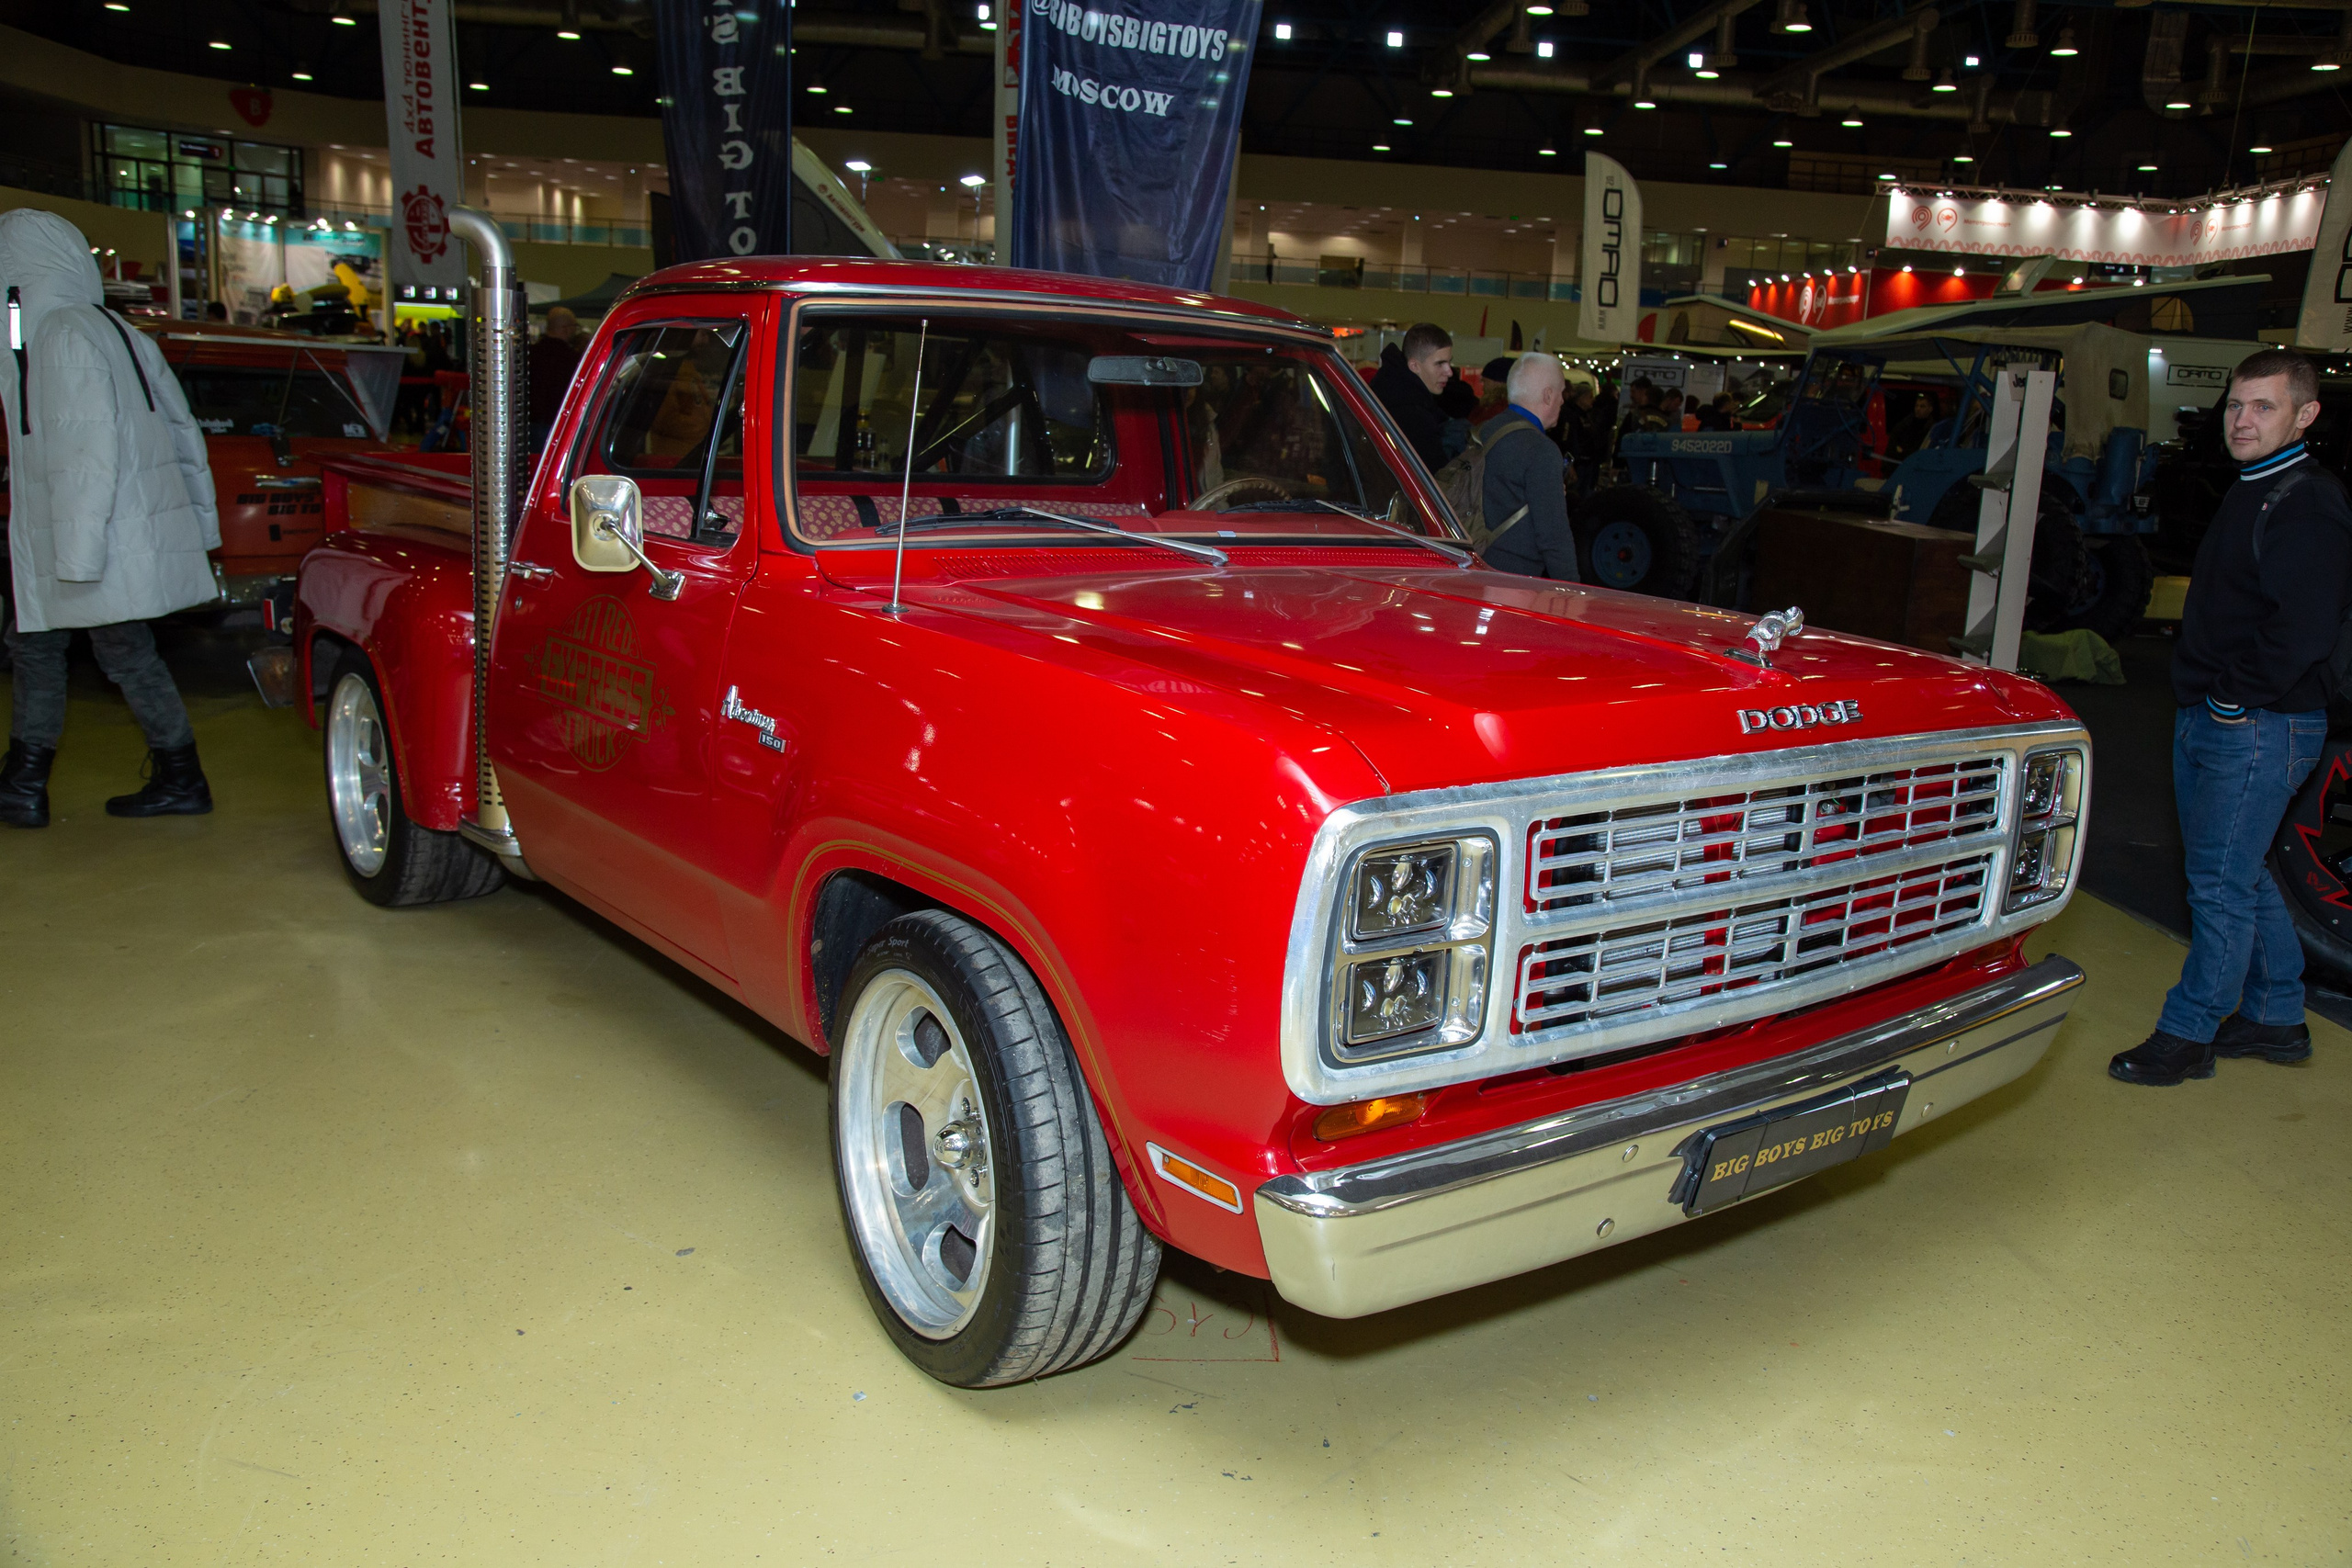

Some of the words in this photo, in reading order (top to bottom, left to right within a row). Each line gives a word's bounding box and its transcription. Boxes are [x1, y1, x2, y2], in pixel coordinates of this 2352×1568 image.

[413, 0, 435, 159] Автовент
[544, 642, 648, 727] EXPRESS
[1736, 690, 1864, 735] DODGE
[562, 707, 617, 764] TRUCK
[761, 734, 782, 750] 150
[888, 936, 910, 948] Sport
[1710, 1154, 1750, 1182] BIG
[1753, 1136, 1807, 1168] BOYS
[1808, 1125, 1846, 1151] BIG
[1848, 1110, 1894, 1139] TOYS
